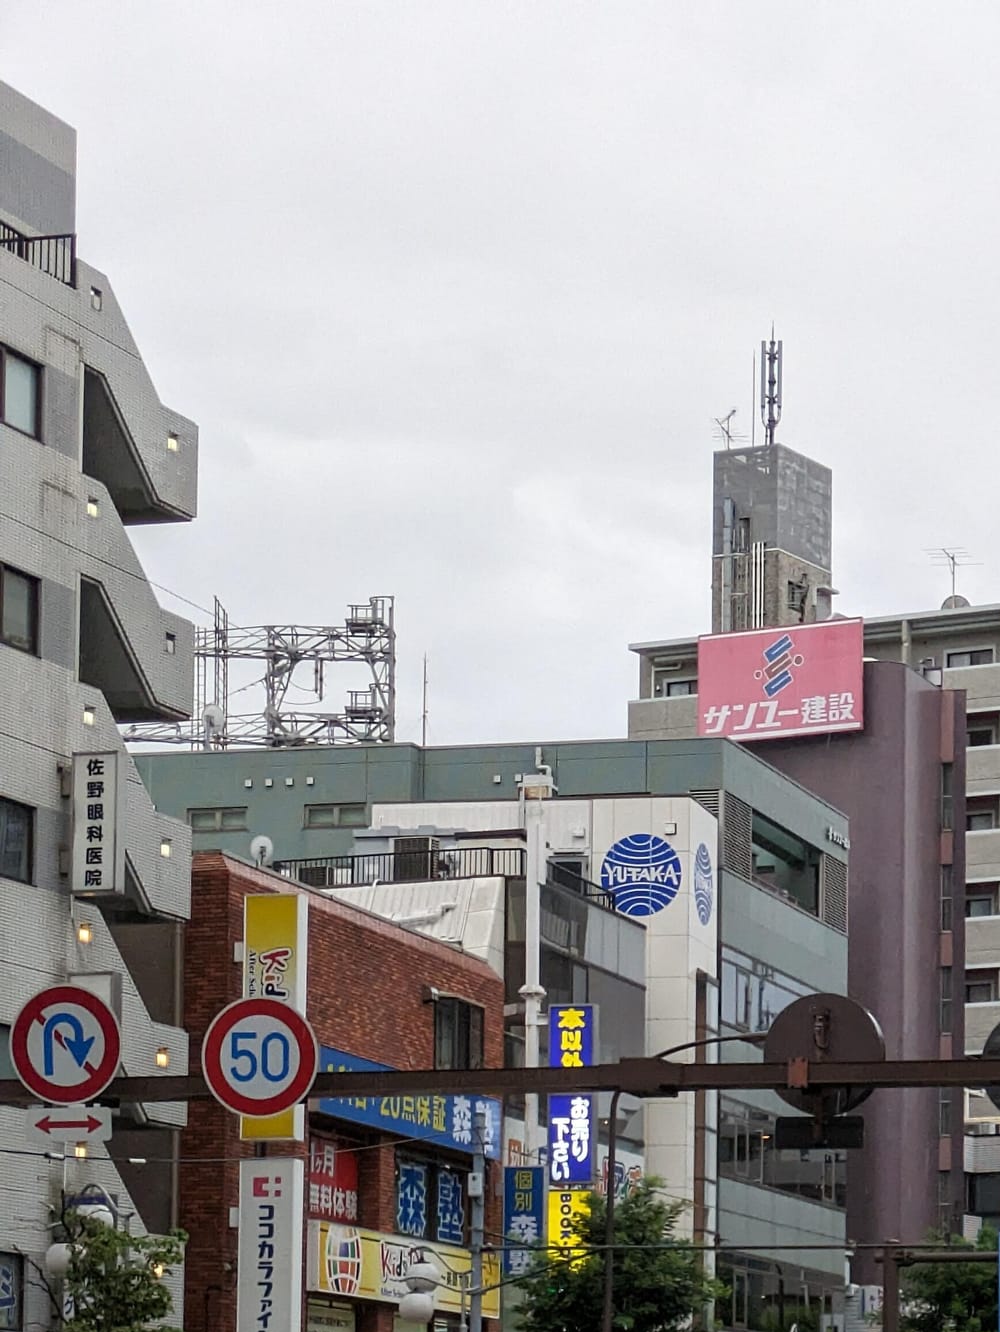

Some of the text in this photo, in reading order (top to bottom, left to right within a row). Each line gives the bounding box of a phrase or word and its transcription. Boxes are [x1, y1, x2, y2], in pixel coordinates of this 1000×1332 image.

[704, 692, 855, 734] サンユー建設
[84, 758, 105, 887] 佐野眼科医院
[604, 863, 678, 886] YUTAKA
[230, 1032, 290, 1082] 50
[552, 1117, 570, 1181] 下さい
[570, 1096, 590, 1162] お売り
[514, 1170, 533, 1212] 個別
